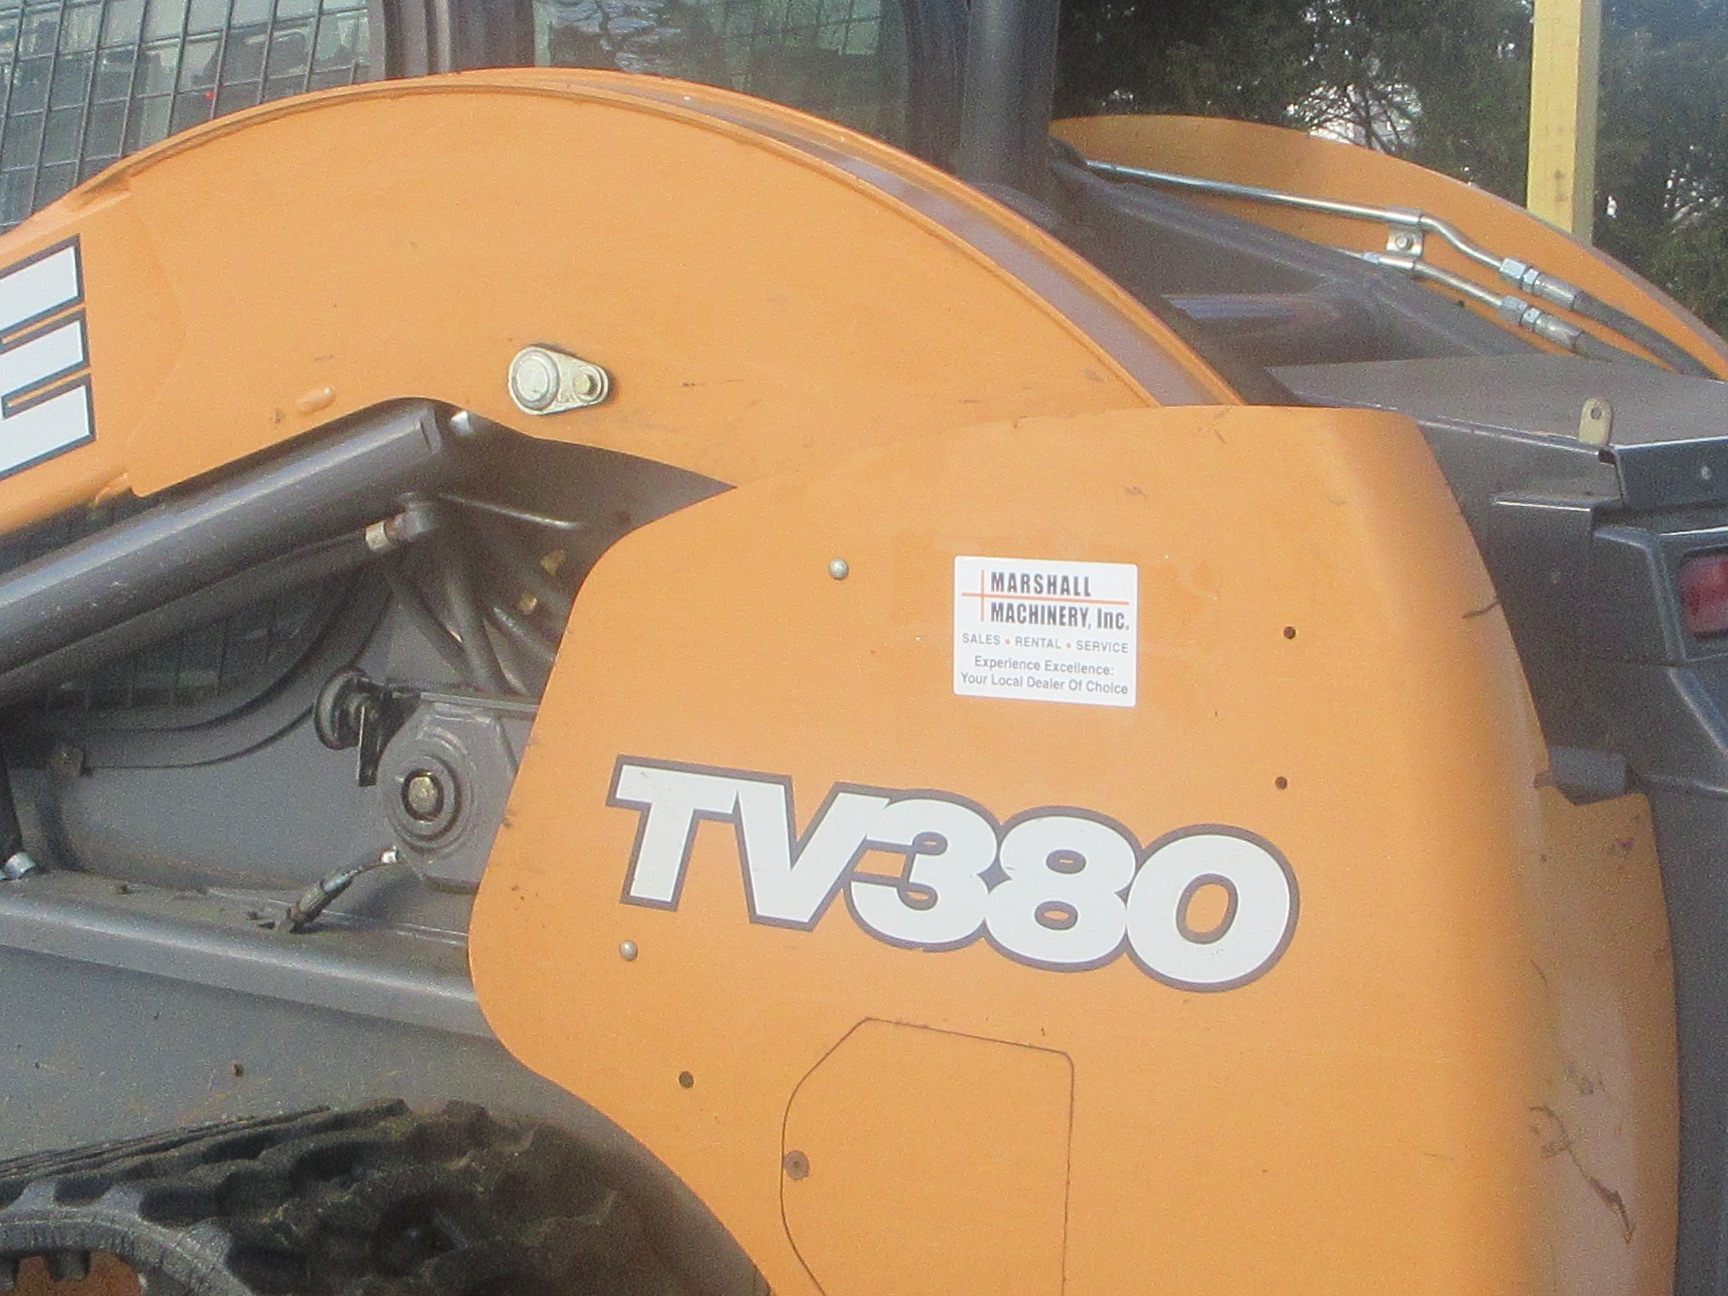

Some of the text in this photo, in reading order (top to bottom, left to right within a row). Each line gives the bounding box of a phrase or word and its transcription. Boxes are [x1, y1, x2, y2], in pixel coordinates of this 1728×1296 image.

[990, 571, 1092, 597] MARSHALL
[990, 602, 1130, 630] MACHINERY, Inc.
[962, 632, 1129, 653] SALES RENTAL SERVICE
[974, 655, 1115, 676] Experience Excellence:
[961, 672, 1129, 695] Your Local Dealer Of Choice
[606, 754, 1300, 994] TV380
